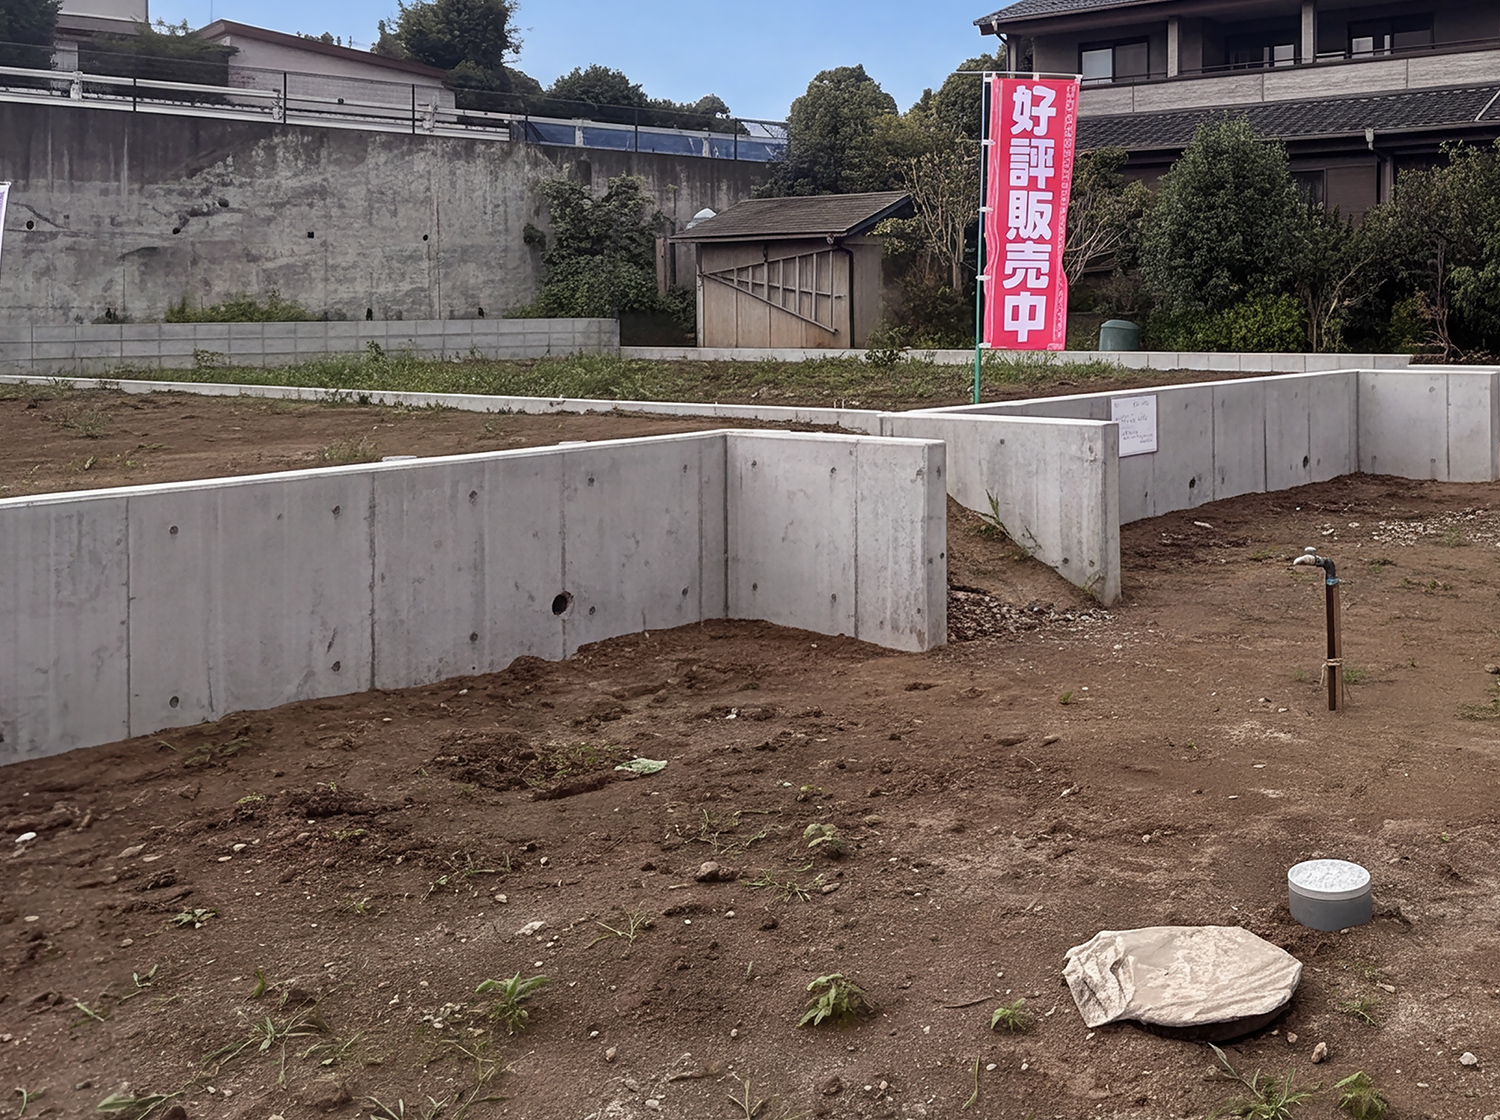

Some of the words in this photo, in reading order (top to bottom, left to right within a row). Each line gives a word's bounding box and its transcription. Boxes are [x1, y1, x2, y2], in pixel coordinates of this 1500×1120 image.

[1003, 85, 1057, 343] 好評販売中
